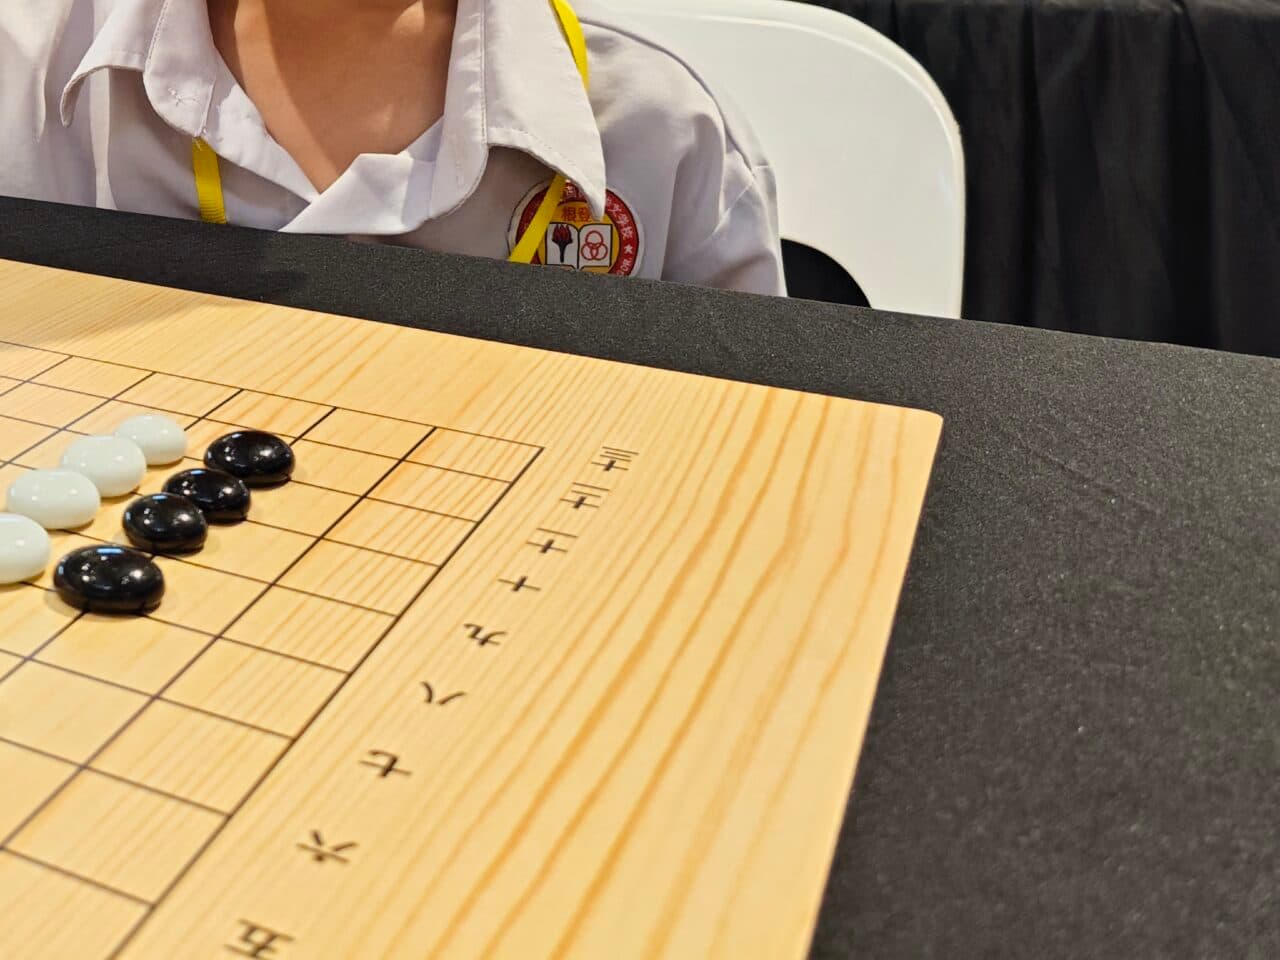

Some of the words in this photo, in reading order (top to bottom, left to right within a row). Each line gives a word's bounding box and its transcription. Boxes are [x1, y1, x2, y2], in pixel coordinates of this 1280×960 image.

[591, 447, 638, 471] 十三
[560, 482, 610, 509] 十二
[526, 528, 578, 554] 十一
[498, 576, 540, 592] 十
[463, 624, 506, 646] 九
[420, 682, 466, 706] 八
[358, 750, 411, 778] 七
[296, 830, 357, 863] 六
